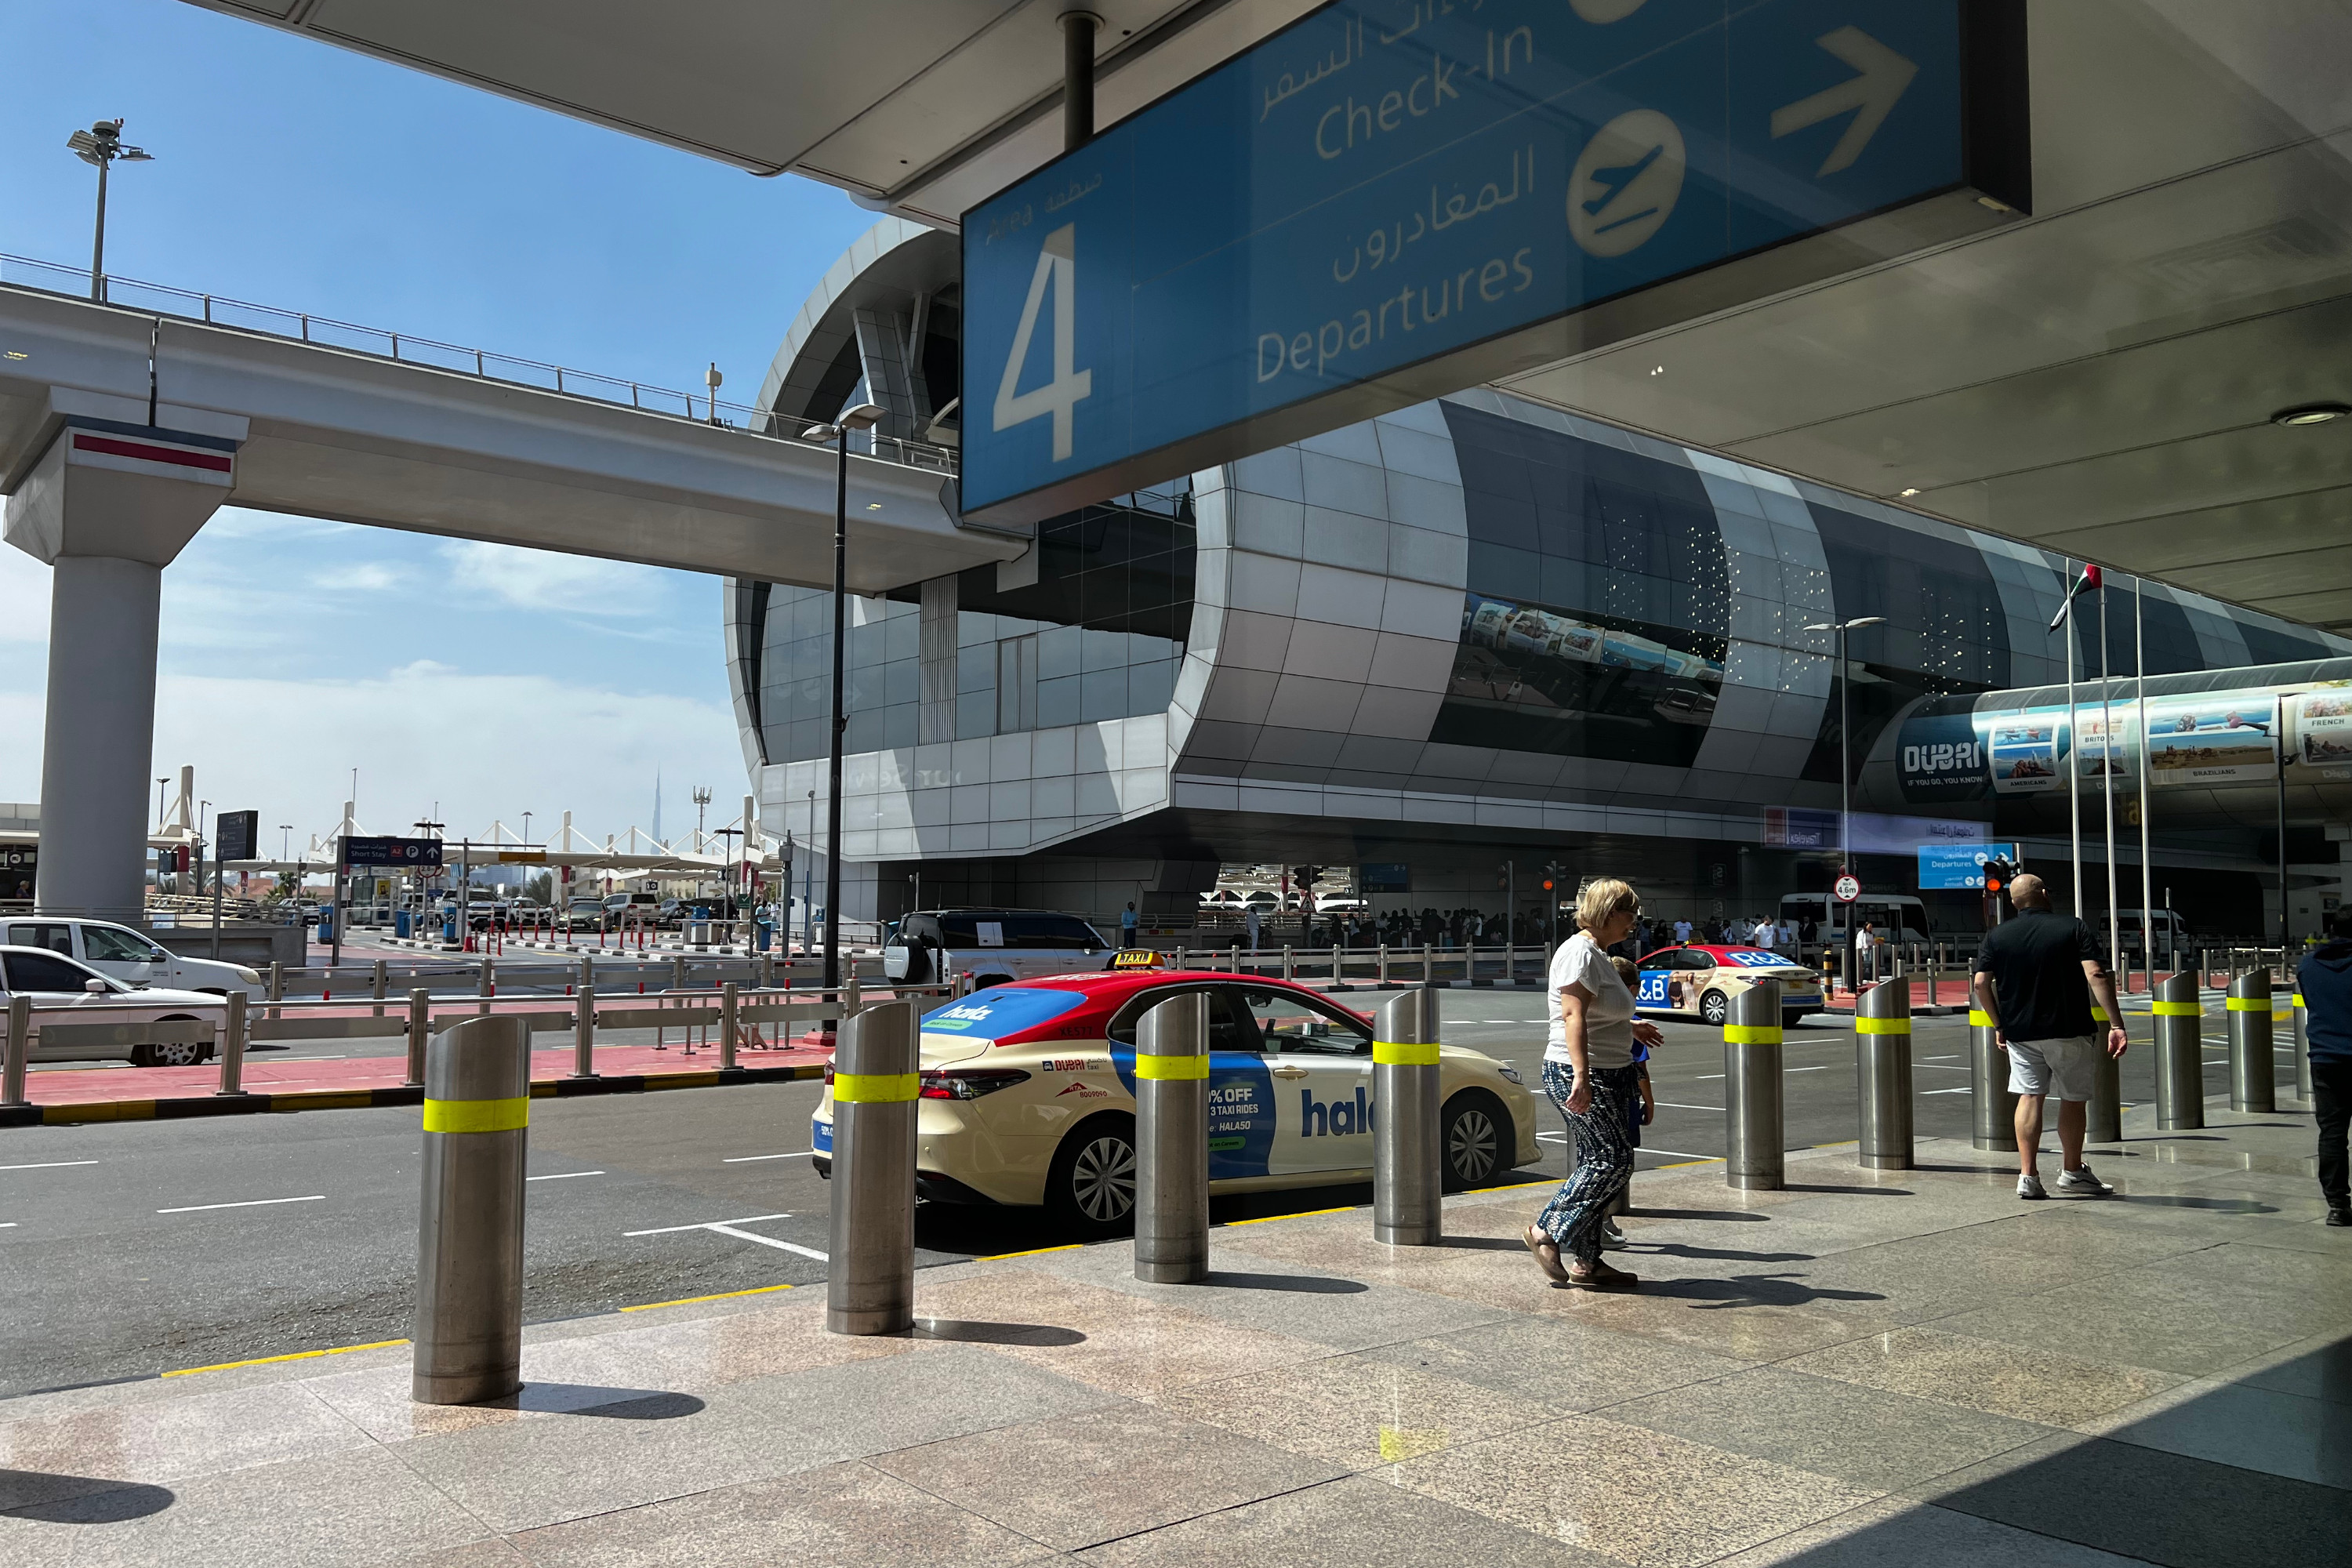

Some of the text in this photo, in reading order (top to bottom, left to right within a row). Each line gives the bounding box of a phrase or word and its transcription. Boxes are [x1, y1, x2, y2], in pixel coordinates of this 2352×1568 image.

[1260, 13, 1363, 123] السفر
[1316, 25, 1533, 158] Check-In
[985, 204, 1034, 246] Area
[1334, 143, 1534, 283] المغادرون
[1257, 248, 1534, 384] Departures
[993, 221, 1091, 463] 4
[1904, 741, 1981, 775] DUBAI
[448, 913, 455, 924] 2
[1123, 953, 1146, 963] TAXI
[1730, 952, 1796, 966] R&B
[1054, 1059, 1085, 1072] DUBAI
[1225, 1088, 1253, 1102] OFF
[1210, 1104, 1258, 1116] 3 TAXI RIDES
[1219, 1121, 1250, 1131] HALA50
